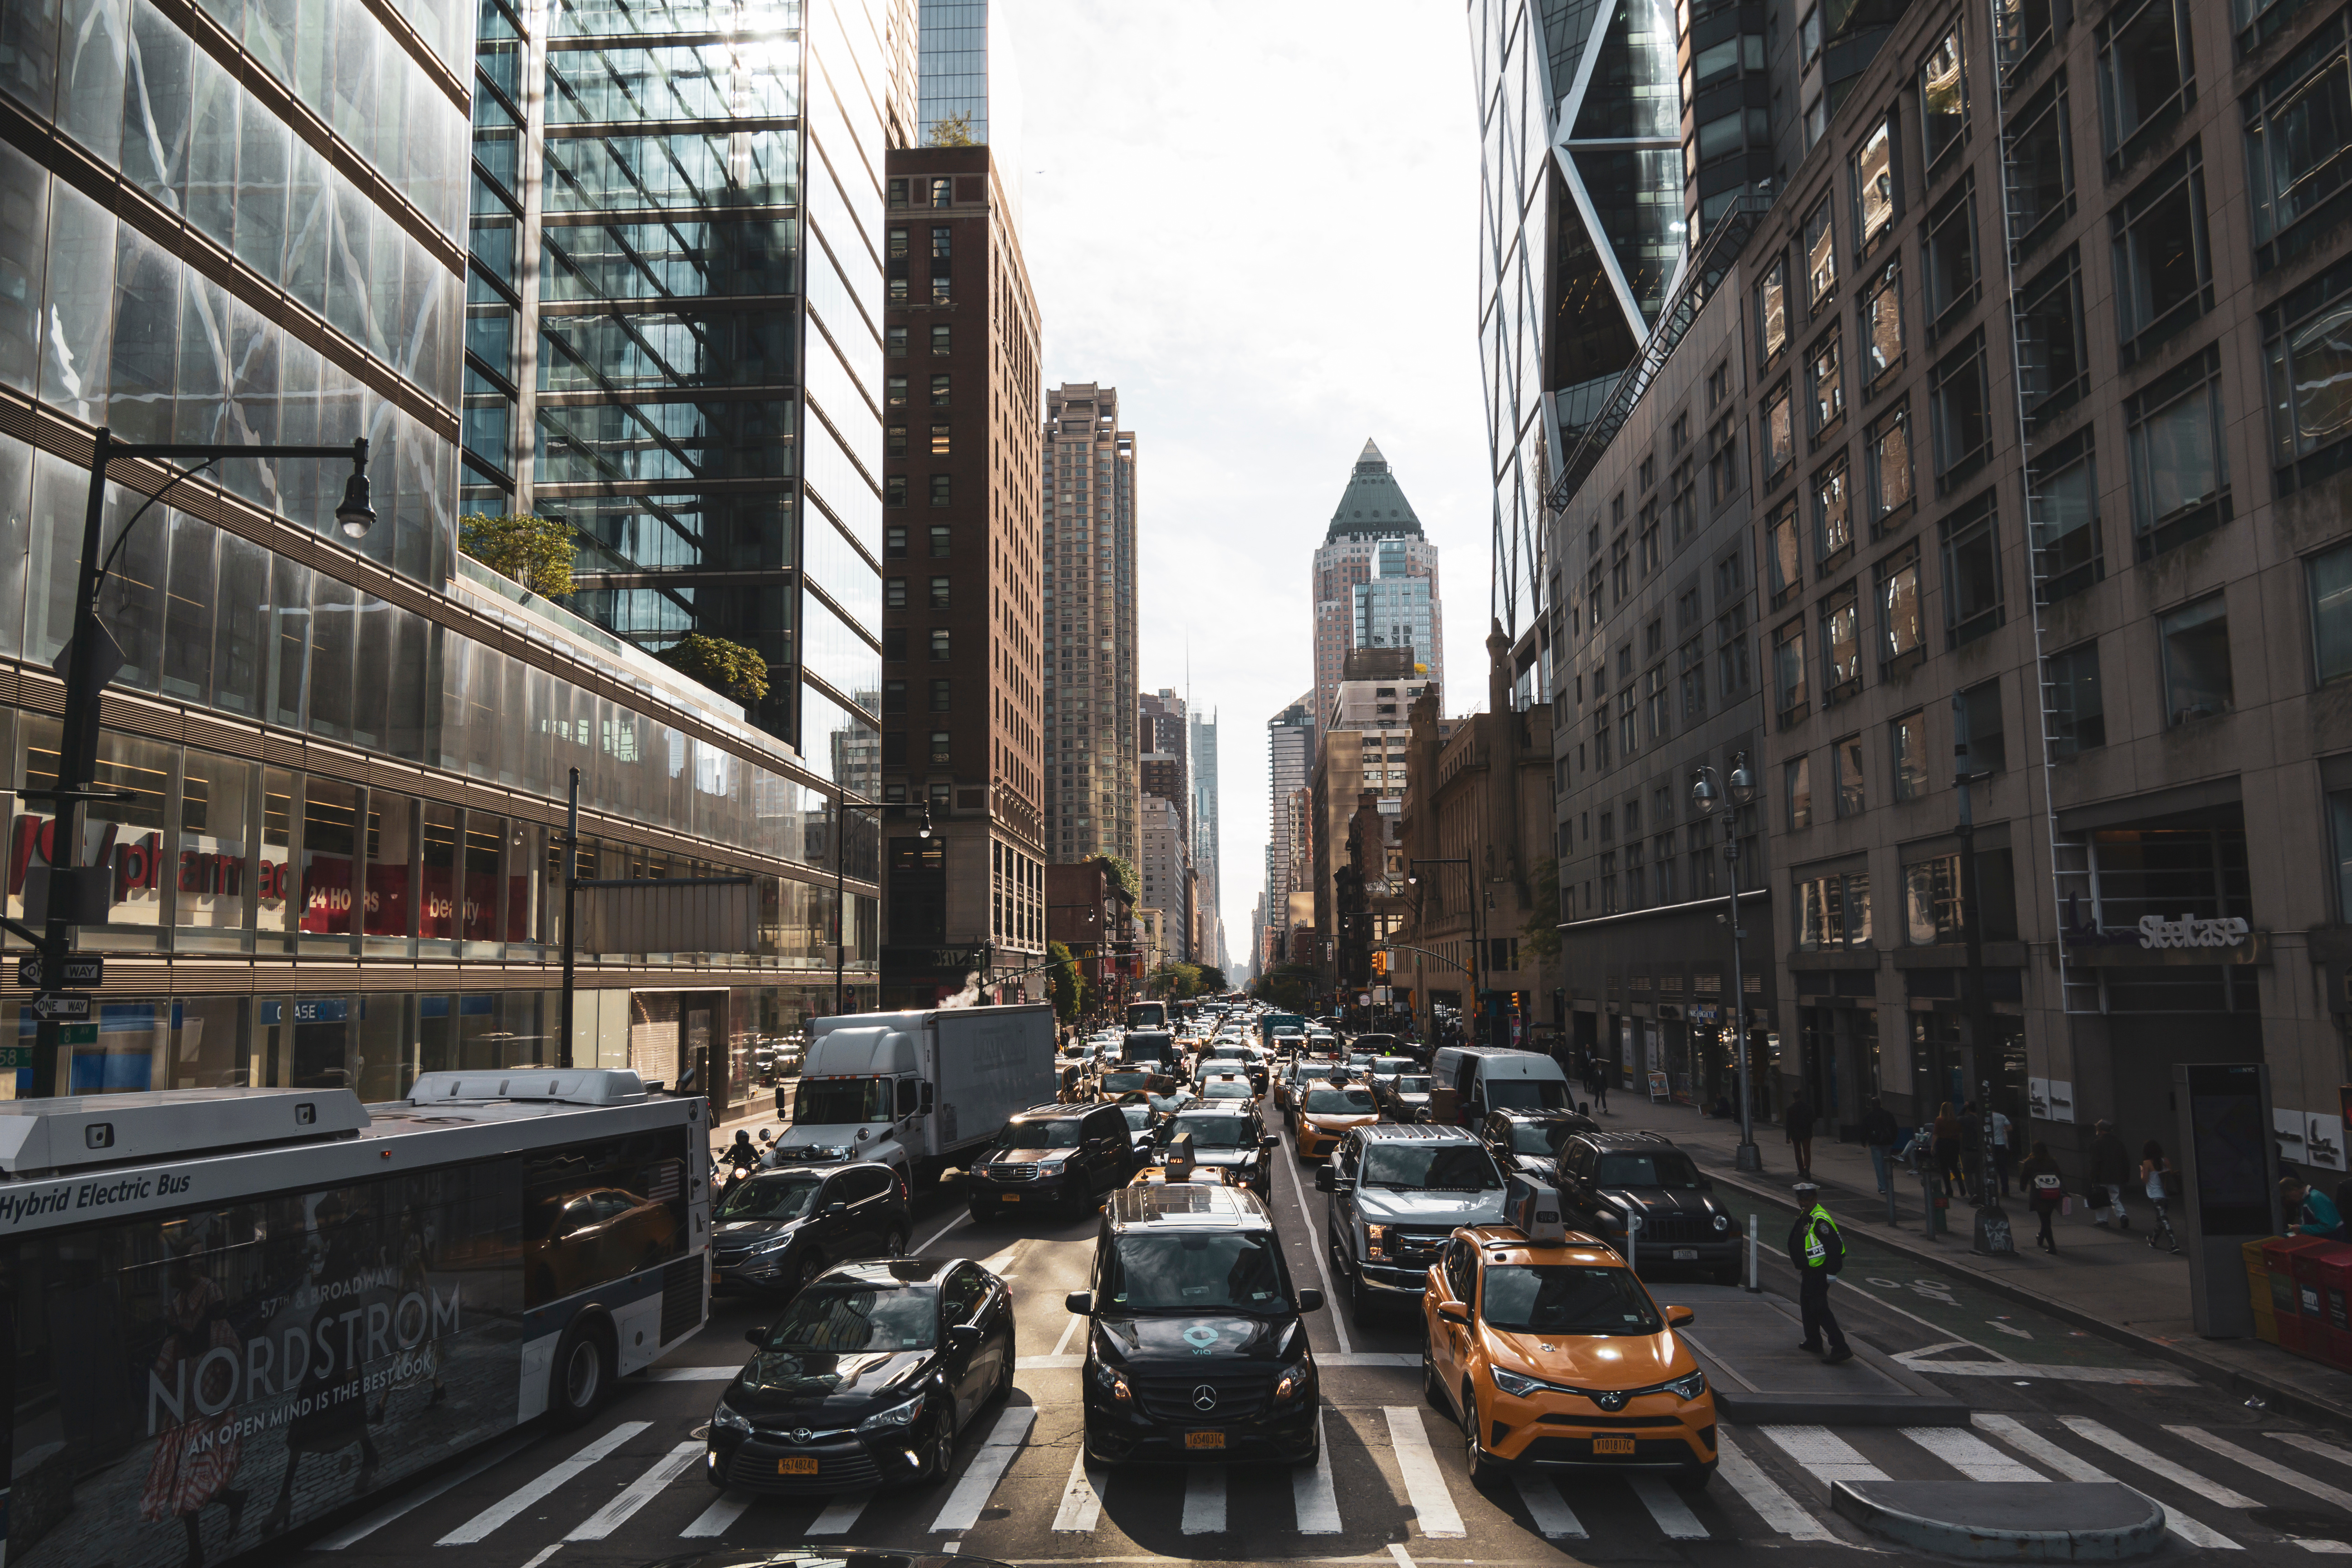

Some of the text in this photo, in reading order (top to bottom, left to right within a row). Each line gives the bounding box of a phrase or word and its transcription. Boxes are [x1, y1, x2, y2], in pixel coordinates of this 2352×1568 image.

[309, 886, 379, 912] 24 HORS
[2139, 914, 2248, 949] Steelcase
[28, 966, 95, 977] ON WAY
[38, 1000, 86, 1012] ONE WAY
[277, 1004, 316, 1019] CASE
[64, 1026, 90, 1043] 8 AV
[0, 1174, 191, 1224] Hybrid Electric Bus
[1540, 1212, 1555, 1222] 9V46
[310, 1268, 392, 1306] BROADWAY
[147, 1281, 460, 1437] NORDSTROM
[188, 1354, 431, 1457] AN OPEN MIND IS THE BEST LOOK
[1189, 1434, 1222, 1444] T654031C
